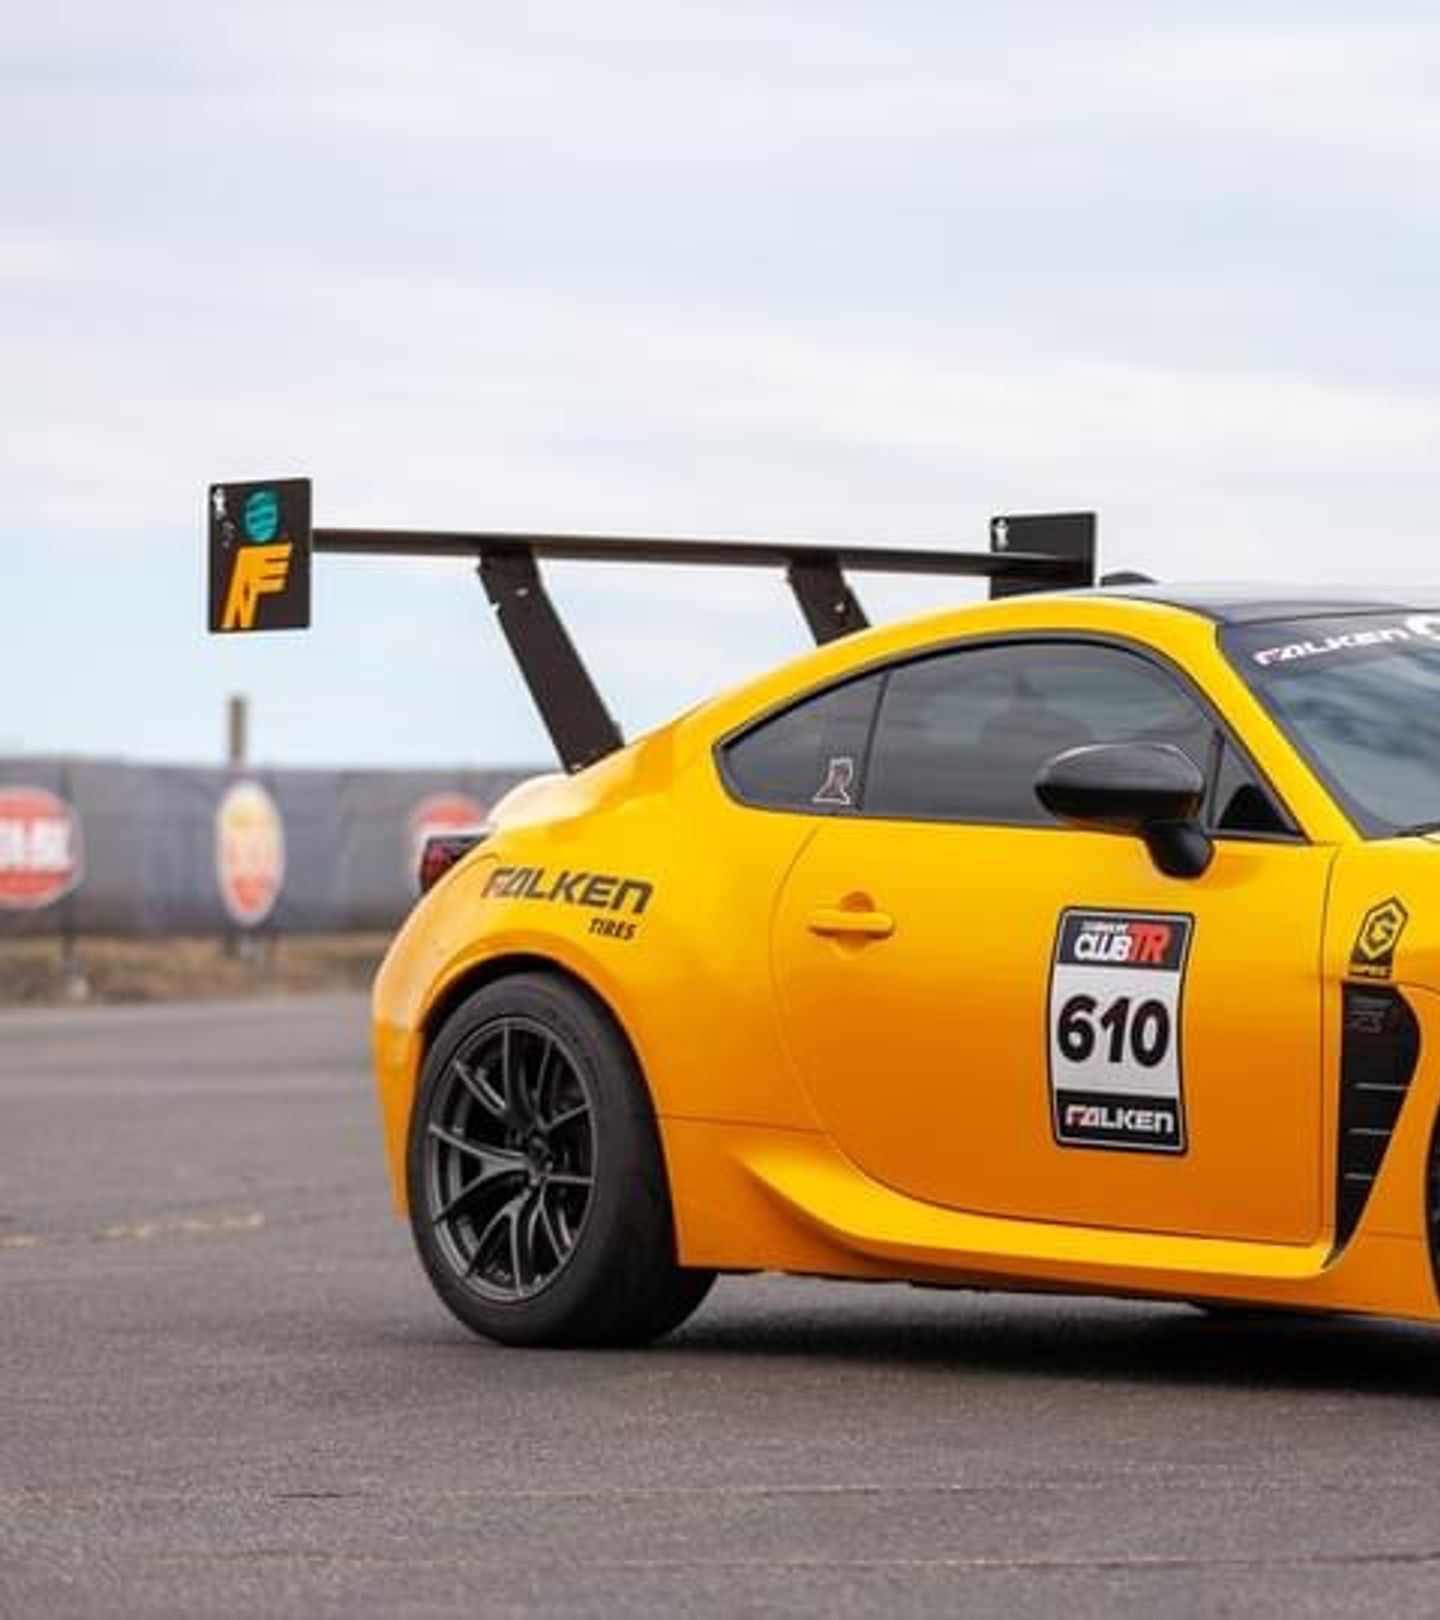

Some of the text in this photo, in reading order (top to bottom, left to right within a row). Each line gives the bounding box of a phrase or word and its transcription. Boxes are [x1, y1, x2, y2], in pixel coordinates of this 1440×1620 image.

[1252, 627, 1410, 666] FALKEN
[480, 867, 654, 915] FALKEN
[588, 918, 637, 941] TIRES
[1057, 994, 1171, 1067] 610
[1065, 1104, 1175, 1135] FALKEN
